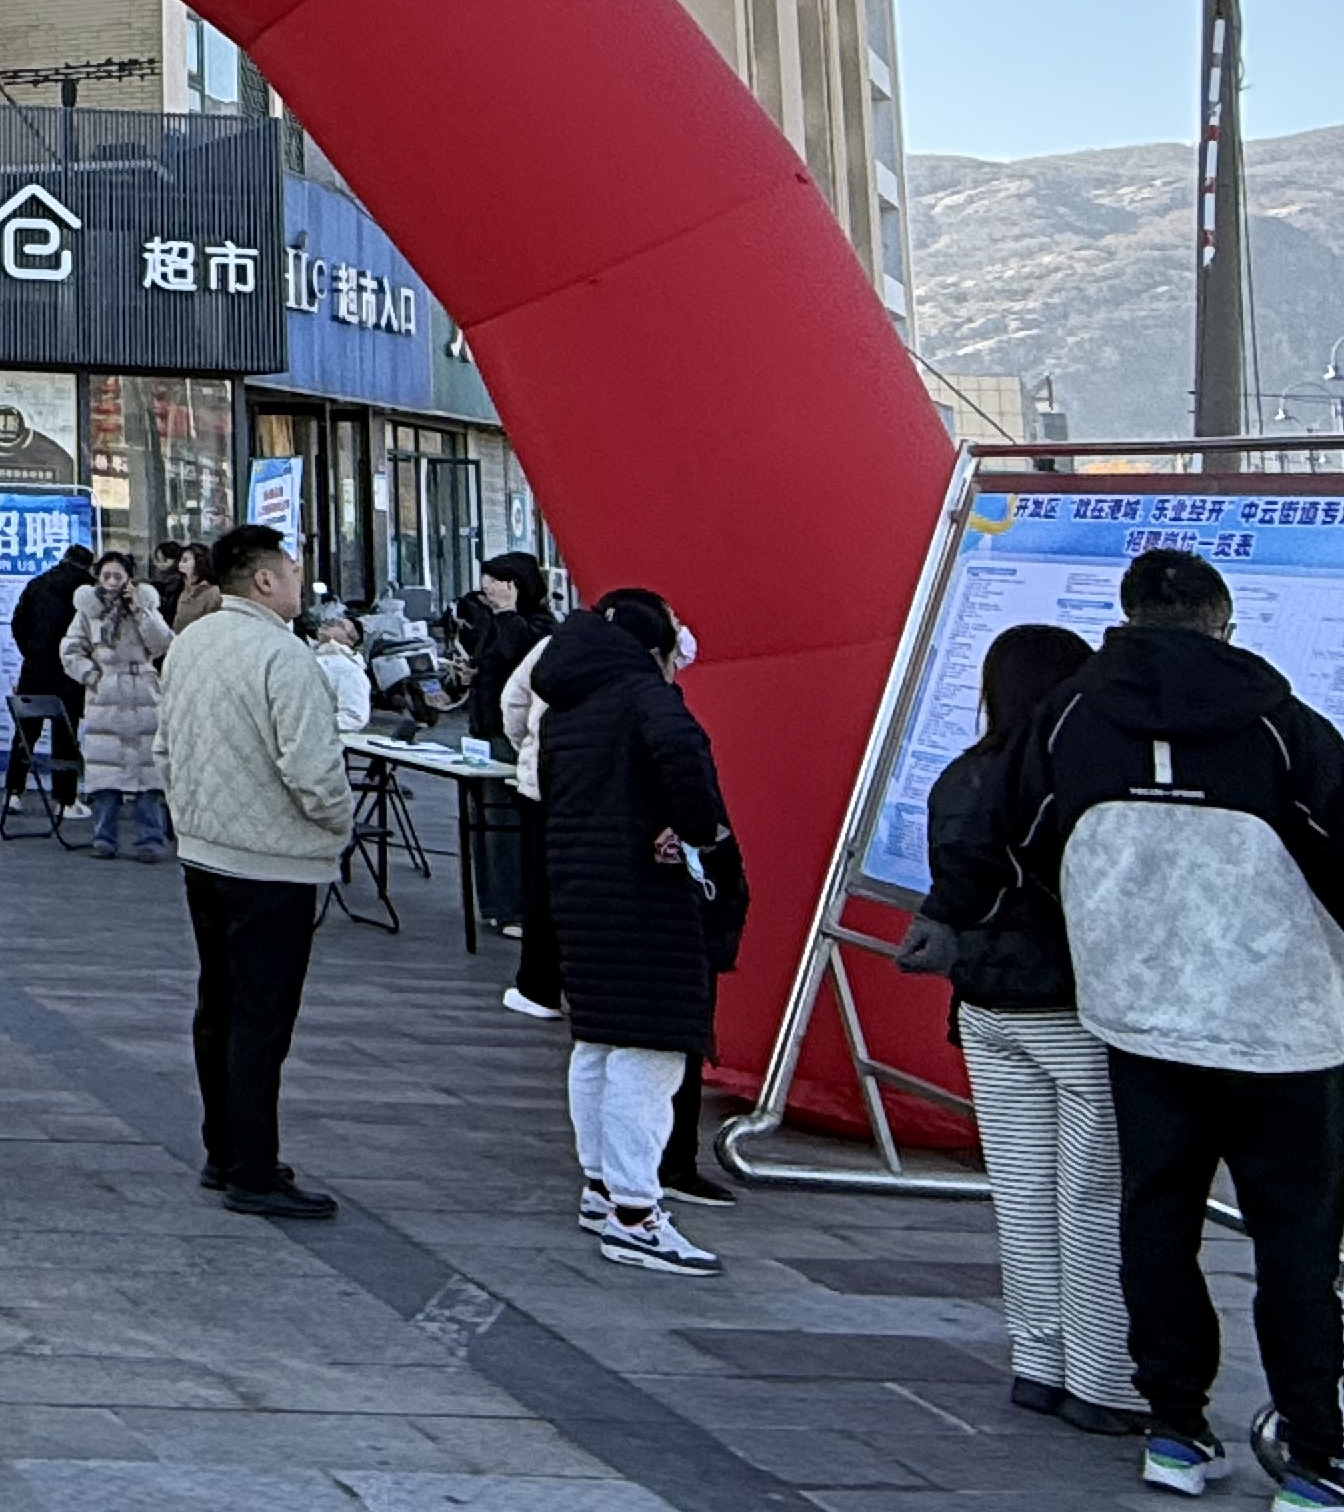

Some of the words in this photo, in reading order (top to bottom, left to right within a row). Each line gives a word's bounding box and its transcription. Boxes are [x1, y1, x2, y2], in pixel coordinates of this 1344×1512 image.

[142, 236, 259, 294] 超市
[335, 261, 416, 336] 超市入口
